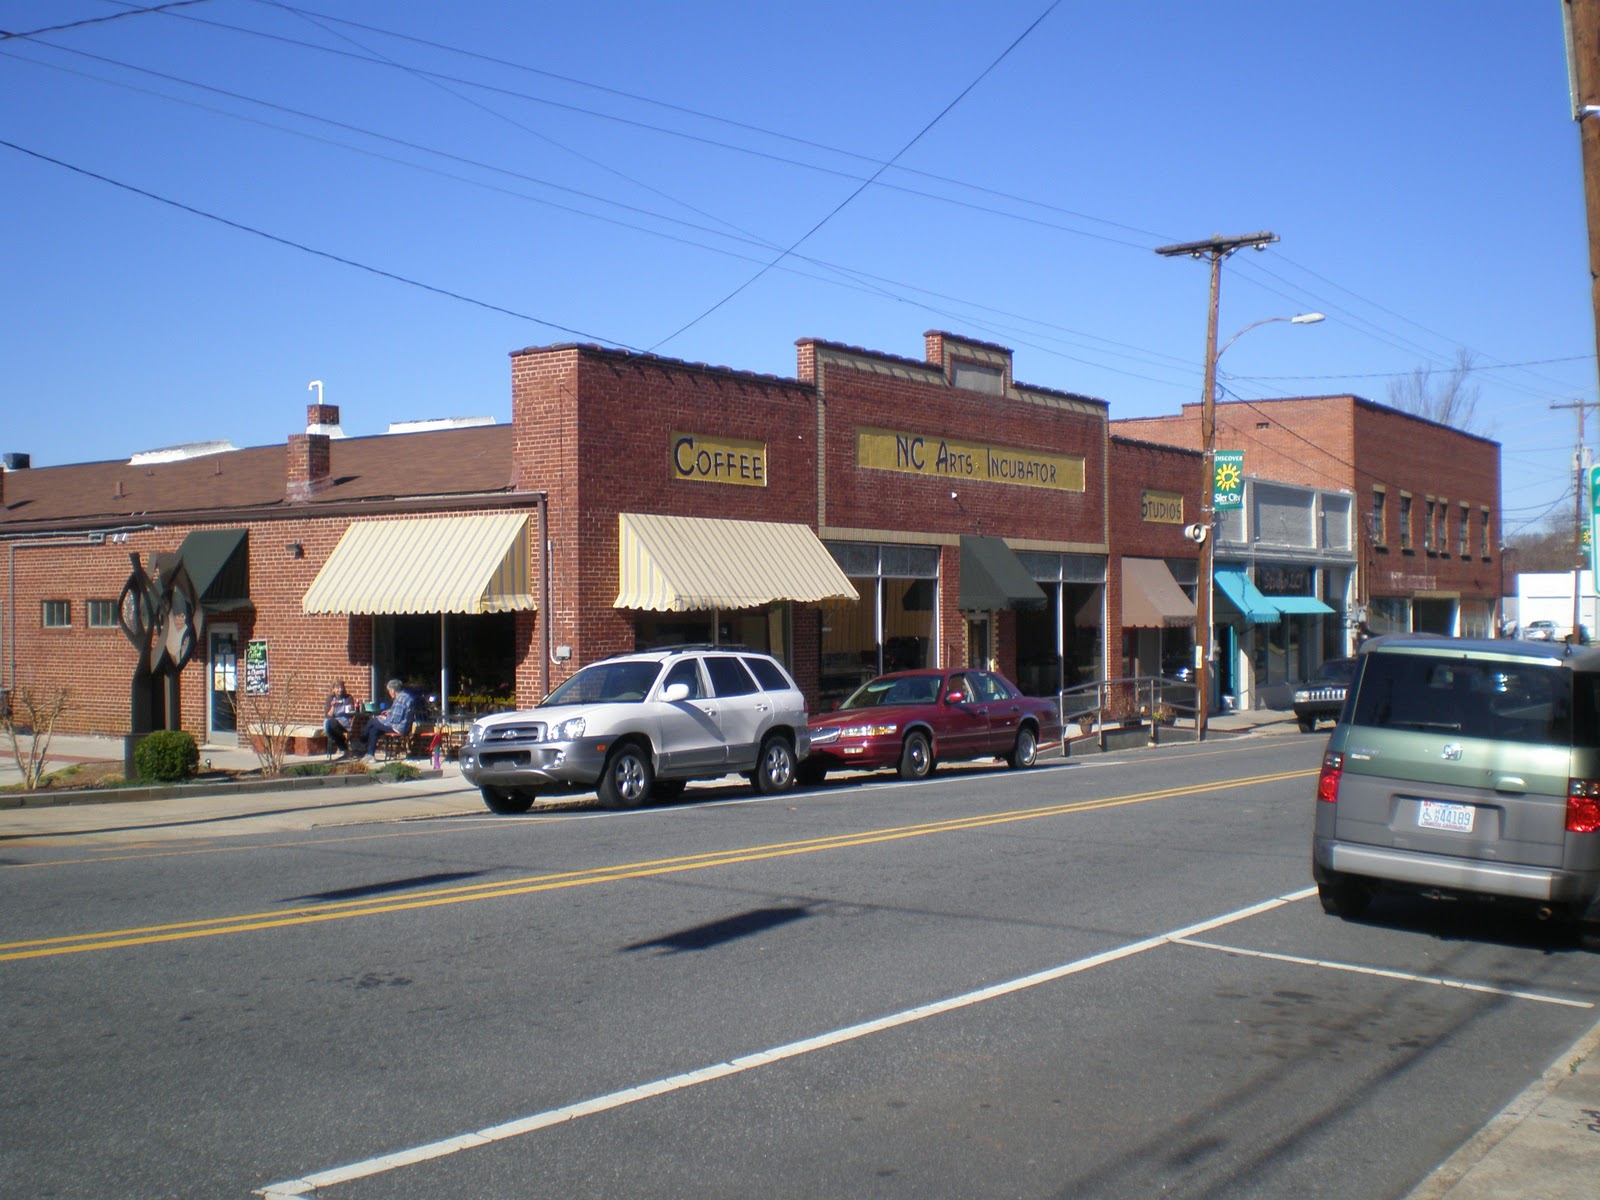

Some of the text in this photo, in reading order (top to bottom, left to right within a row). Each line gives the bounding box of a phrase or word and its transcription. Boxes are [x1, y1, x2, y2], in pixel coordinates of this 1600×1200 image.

[674, 437, 762, 480] COFFEE
[896, 434, 1056, 483] NC ARTS INCUBATOR
[1141, 491, 1181, 520] STUDIOS
[1228, 492, 1241, 503] City
